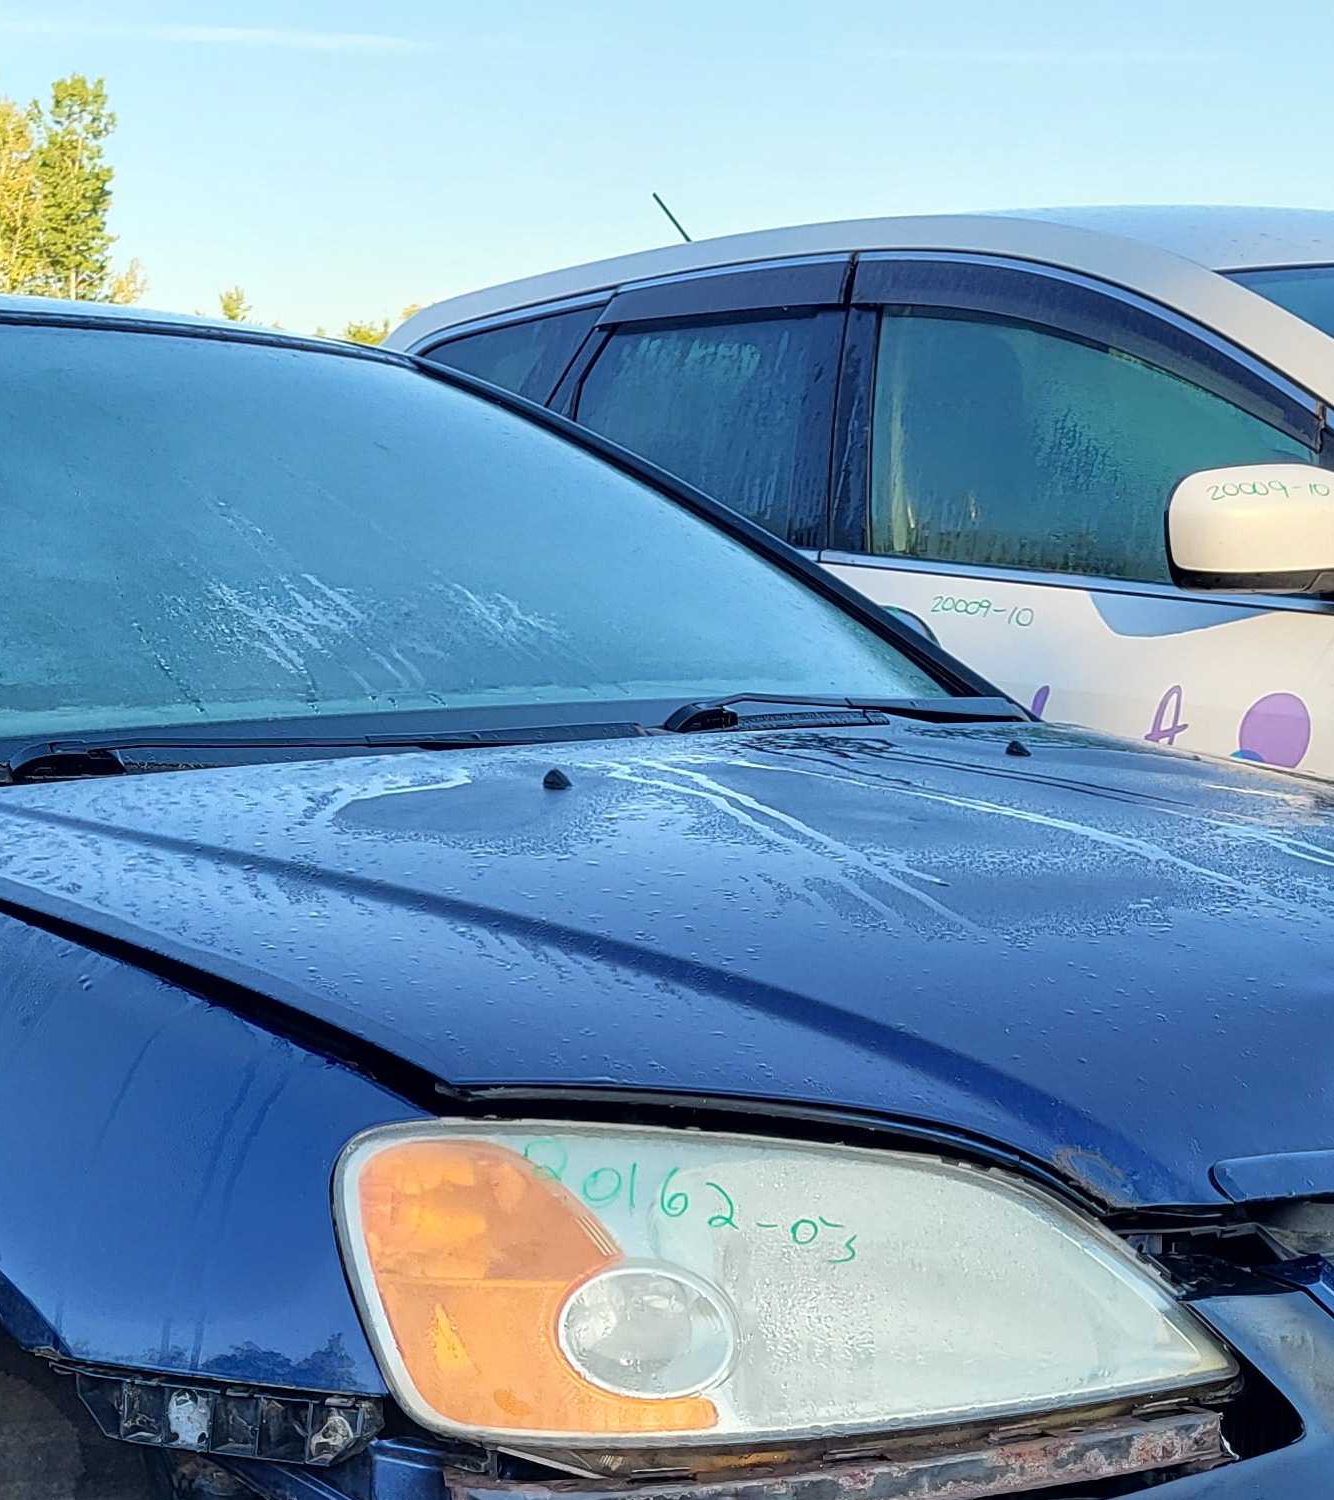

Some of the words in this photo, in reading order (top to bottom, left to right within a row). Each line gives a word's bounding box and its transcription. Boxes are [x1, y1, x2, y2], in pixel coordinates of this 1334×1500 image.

[1206, 479, 1330, 501] 20009-10
[930, 594, 1034, 627] 20009-10
[524, 1138, 858, 1263] 20162-03
